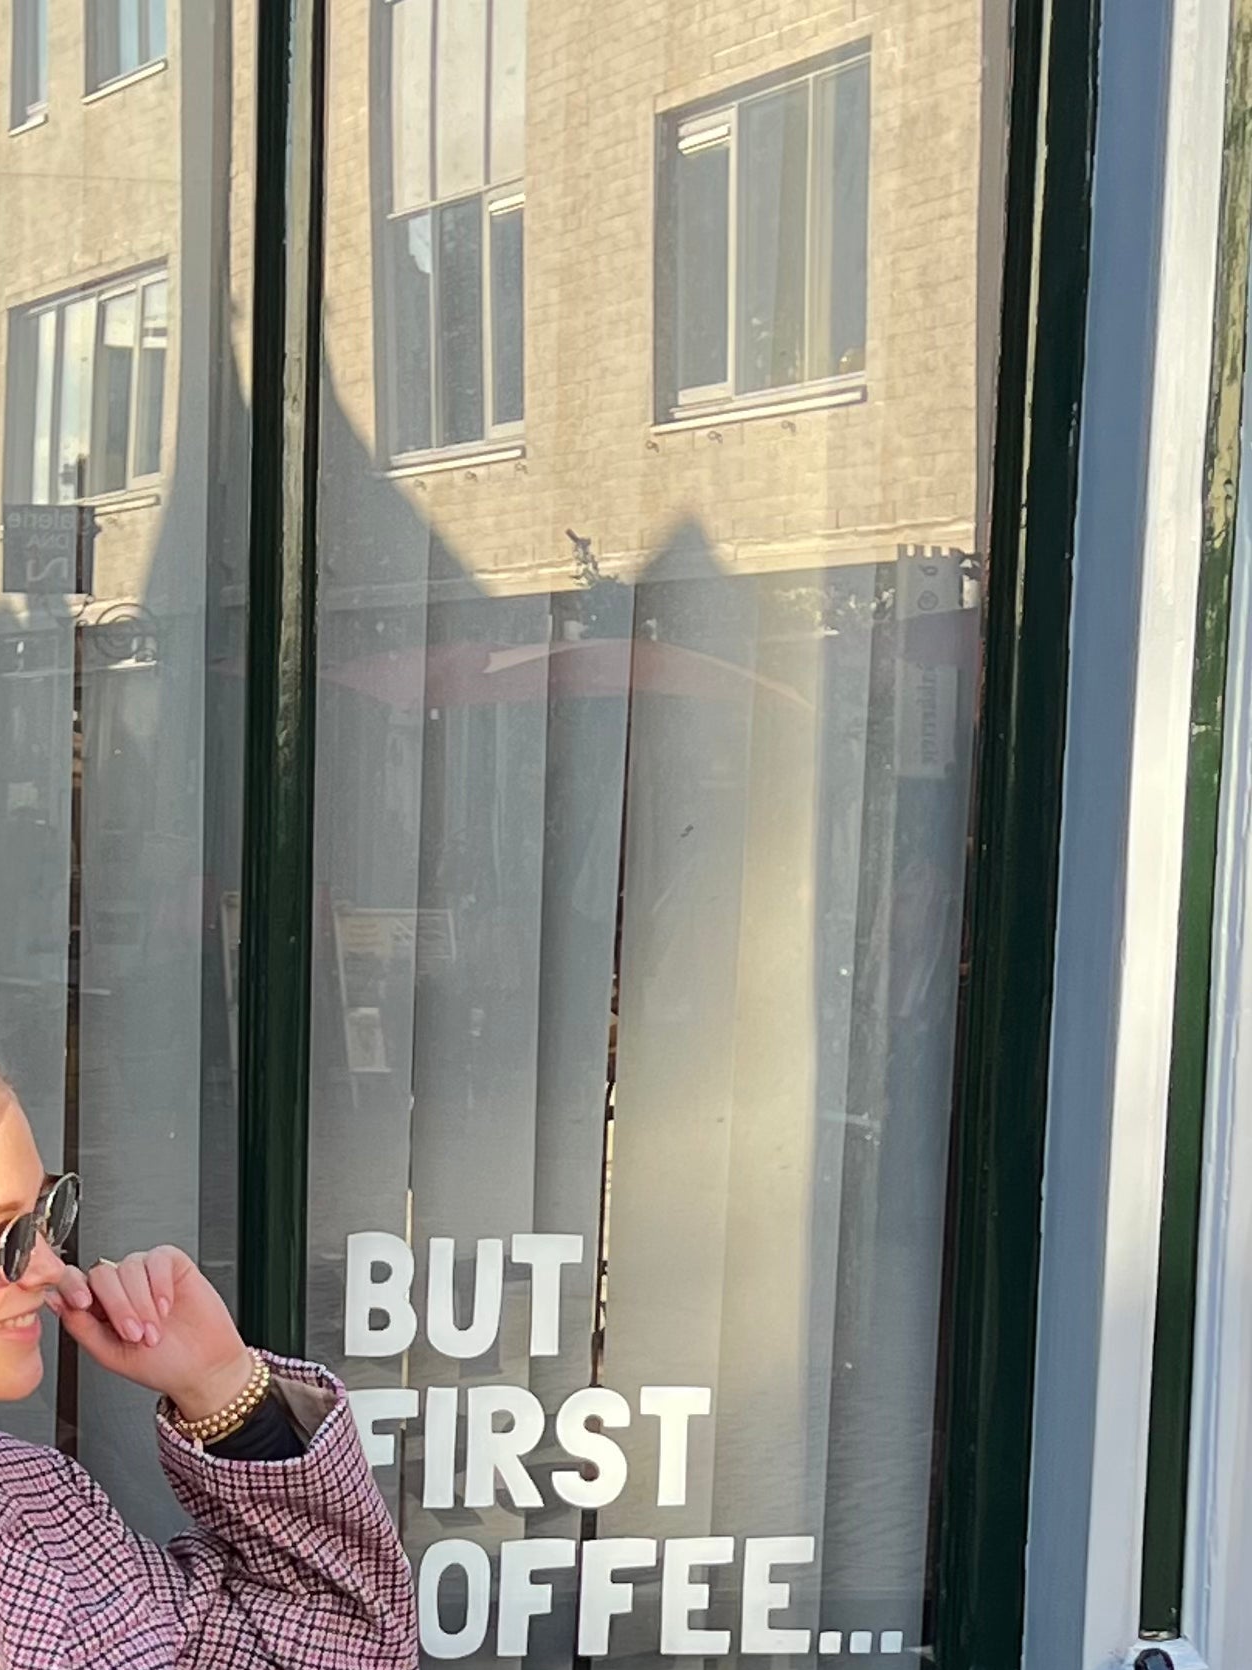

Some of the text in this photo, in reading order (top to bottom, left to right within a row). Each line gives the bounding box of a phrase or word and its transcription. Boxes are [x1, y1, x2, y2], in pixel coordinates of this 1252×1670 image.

[344, 1232, 583, 1358] BUT
[348, 1386, 711, 1508] FIRST
[419, 1535, 903, 1659] OFFEE...
